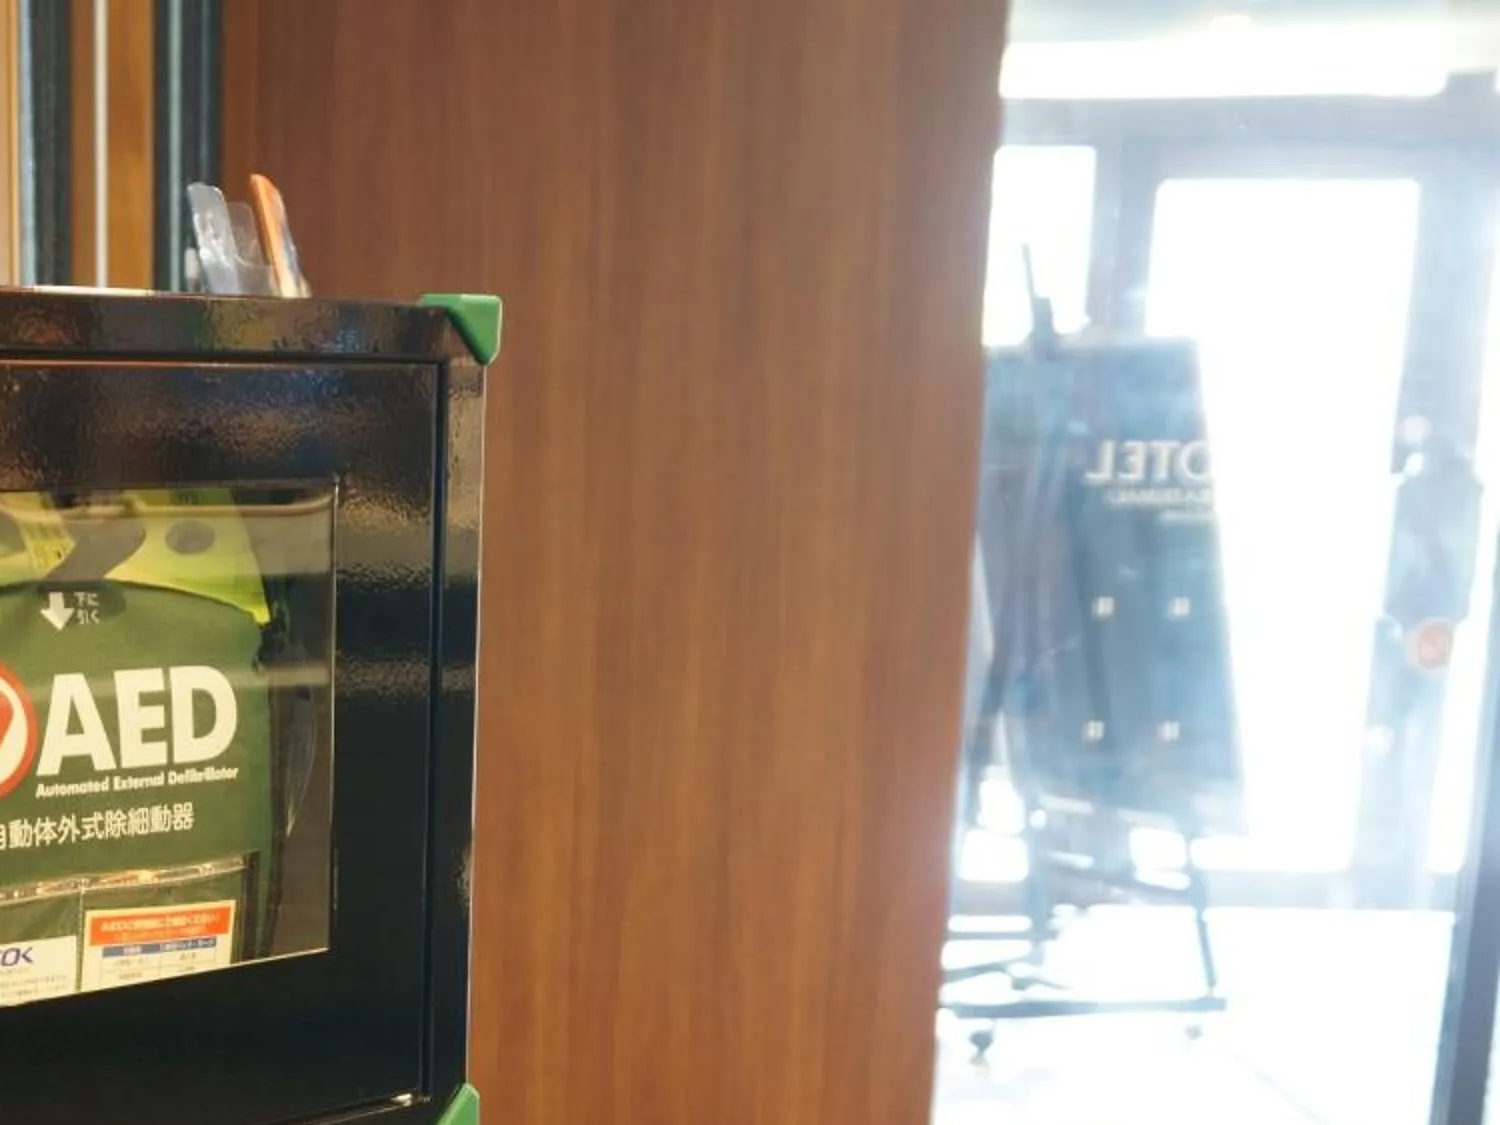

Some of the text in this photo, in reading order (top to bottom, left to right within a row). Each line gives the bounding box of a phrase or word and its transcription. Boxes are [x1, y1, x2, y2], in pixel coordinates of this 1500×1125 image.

[36, 665, 238, 777] AED
[35, 775, 109, 798] Automated
[113, 770, 165, 791] External
